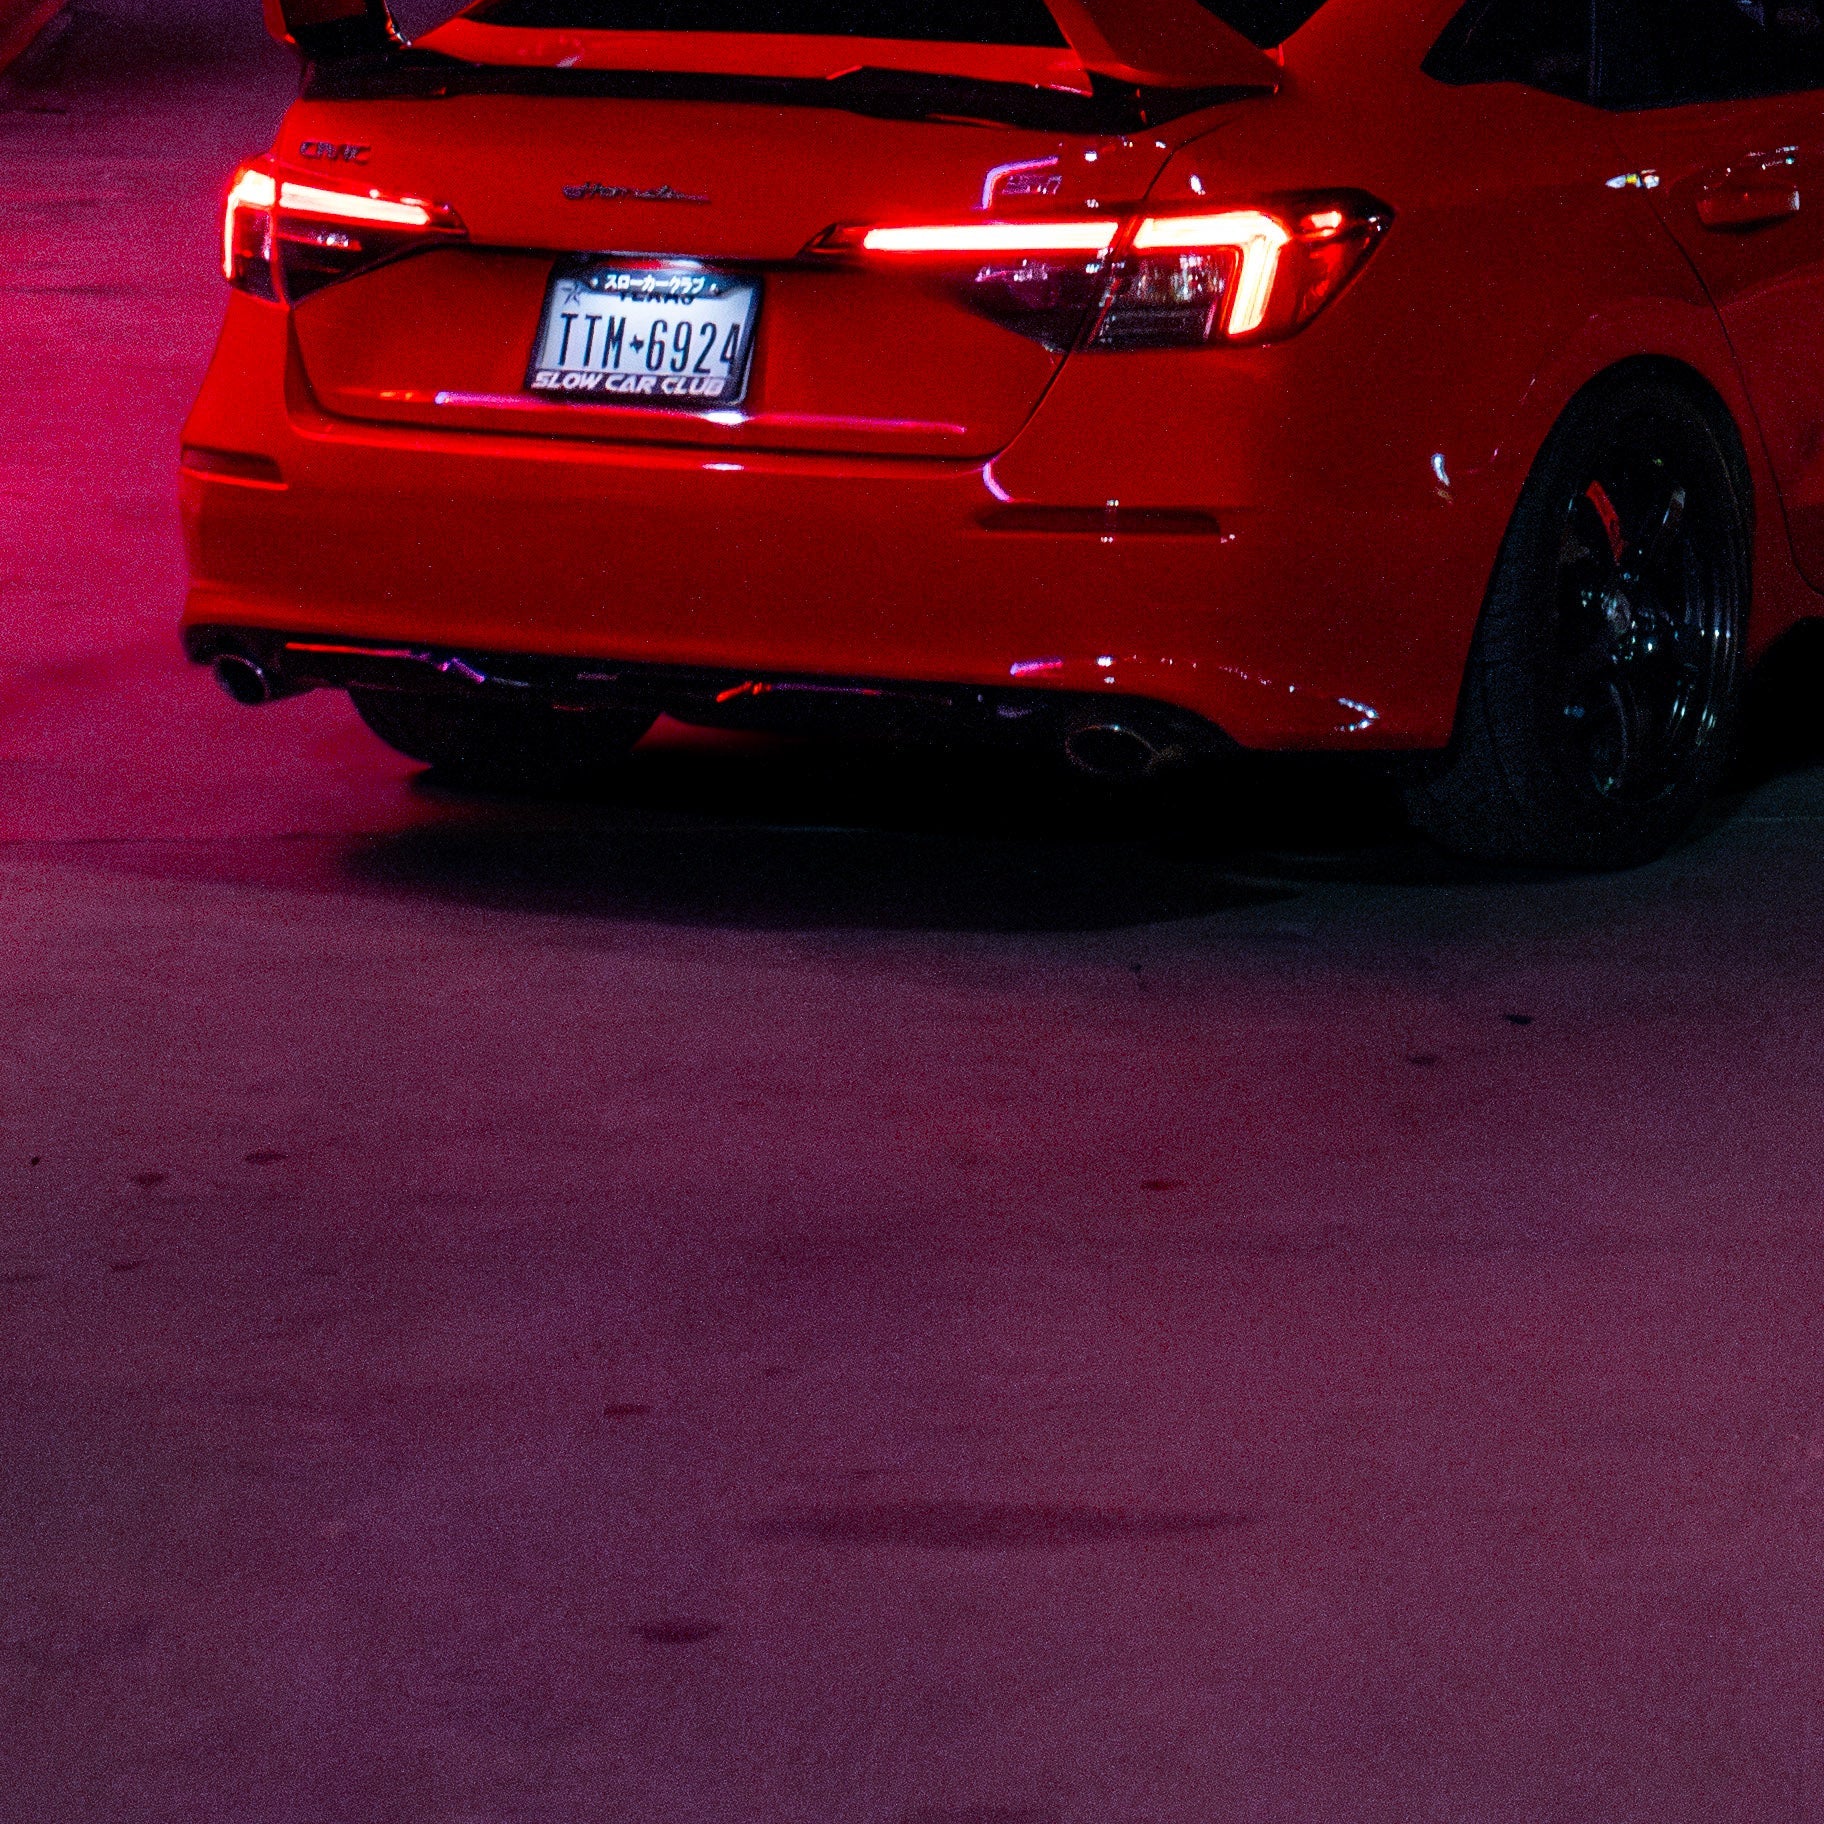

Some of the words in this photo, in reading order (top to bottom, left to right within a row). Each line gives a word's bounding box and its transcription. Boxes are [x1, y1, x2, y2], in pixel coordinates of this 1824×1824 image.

[530, 370, 602, 390] SLOW
[604, 372, 658, 395] CAR
[660, 376, 726, 398] CLUB
